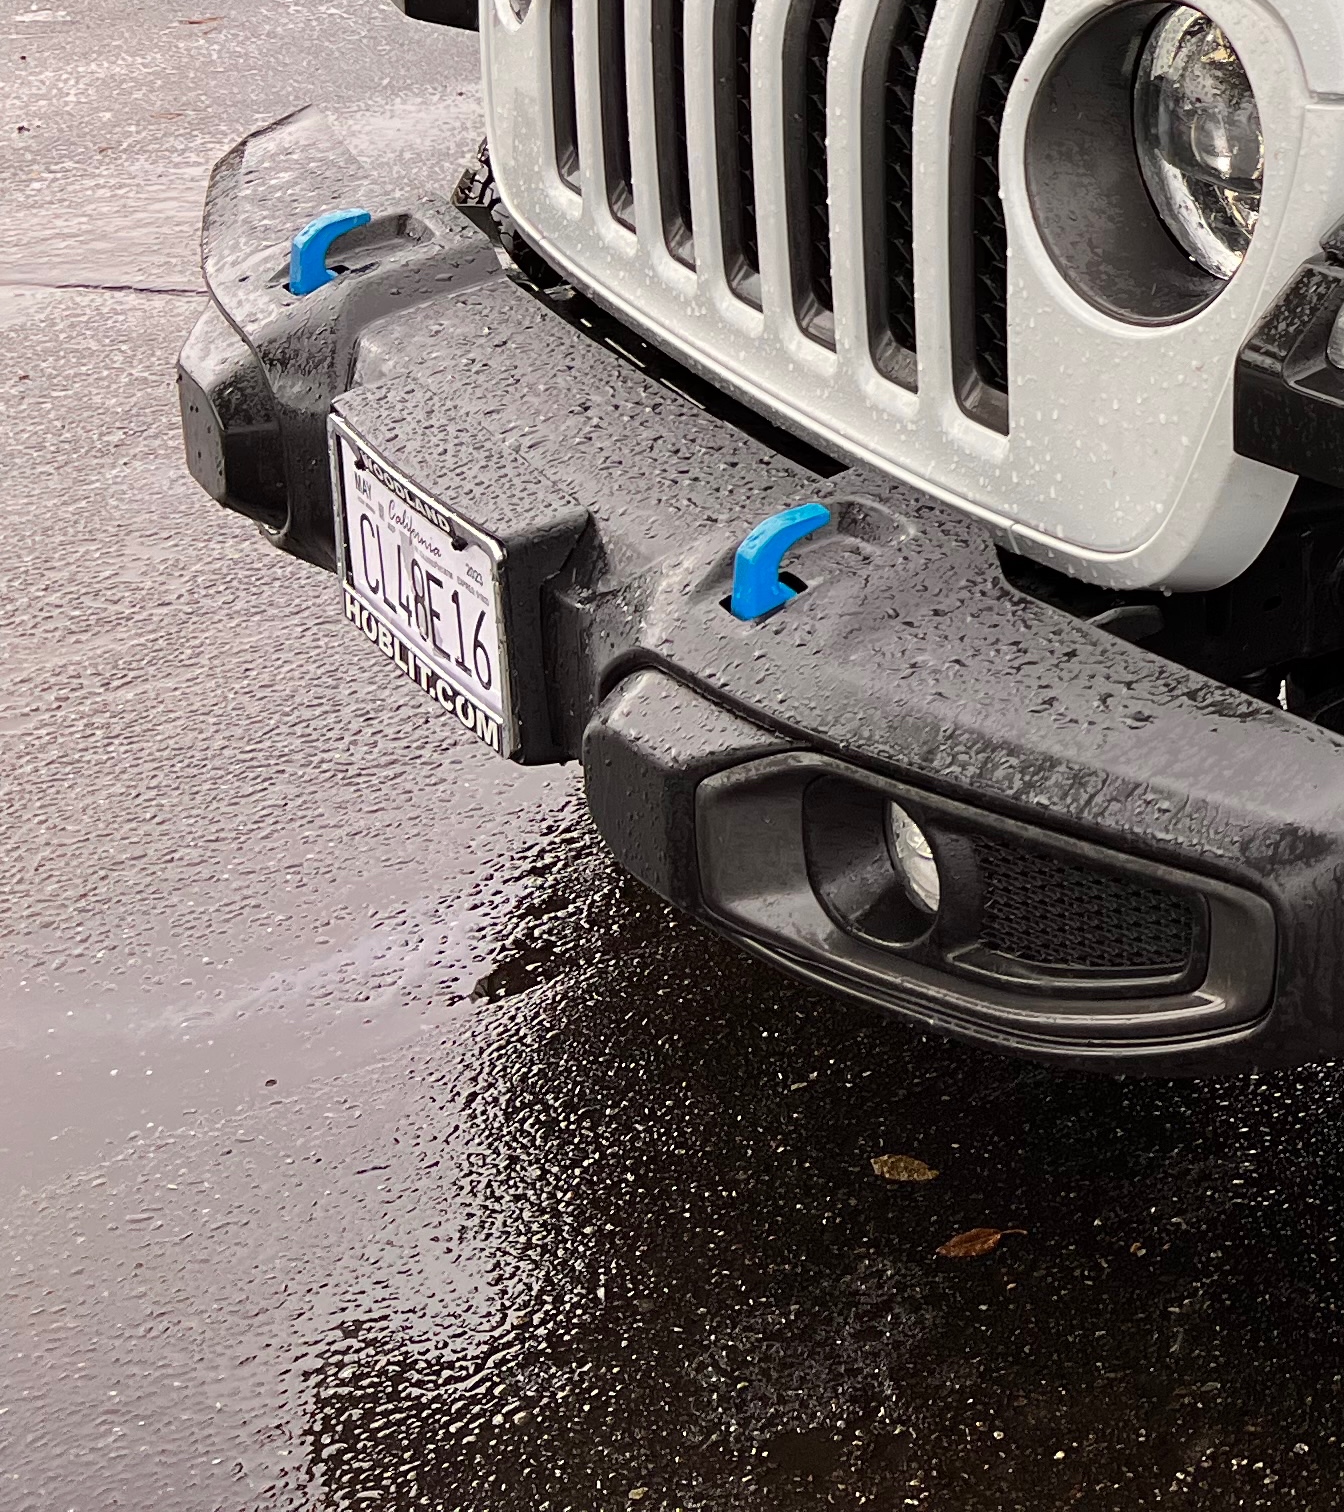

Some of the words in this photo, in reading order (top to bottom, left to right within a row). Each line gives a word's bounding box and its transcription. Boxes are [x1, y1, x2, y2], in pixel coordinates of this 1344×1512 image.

[353, 471, 372, 502] MAY
[388, 498, 442, 558] California
[359, 513, 492, 691] CL48E16
[345, 590, 500, 752] HOBLIT.COM
